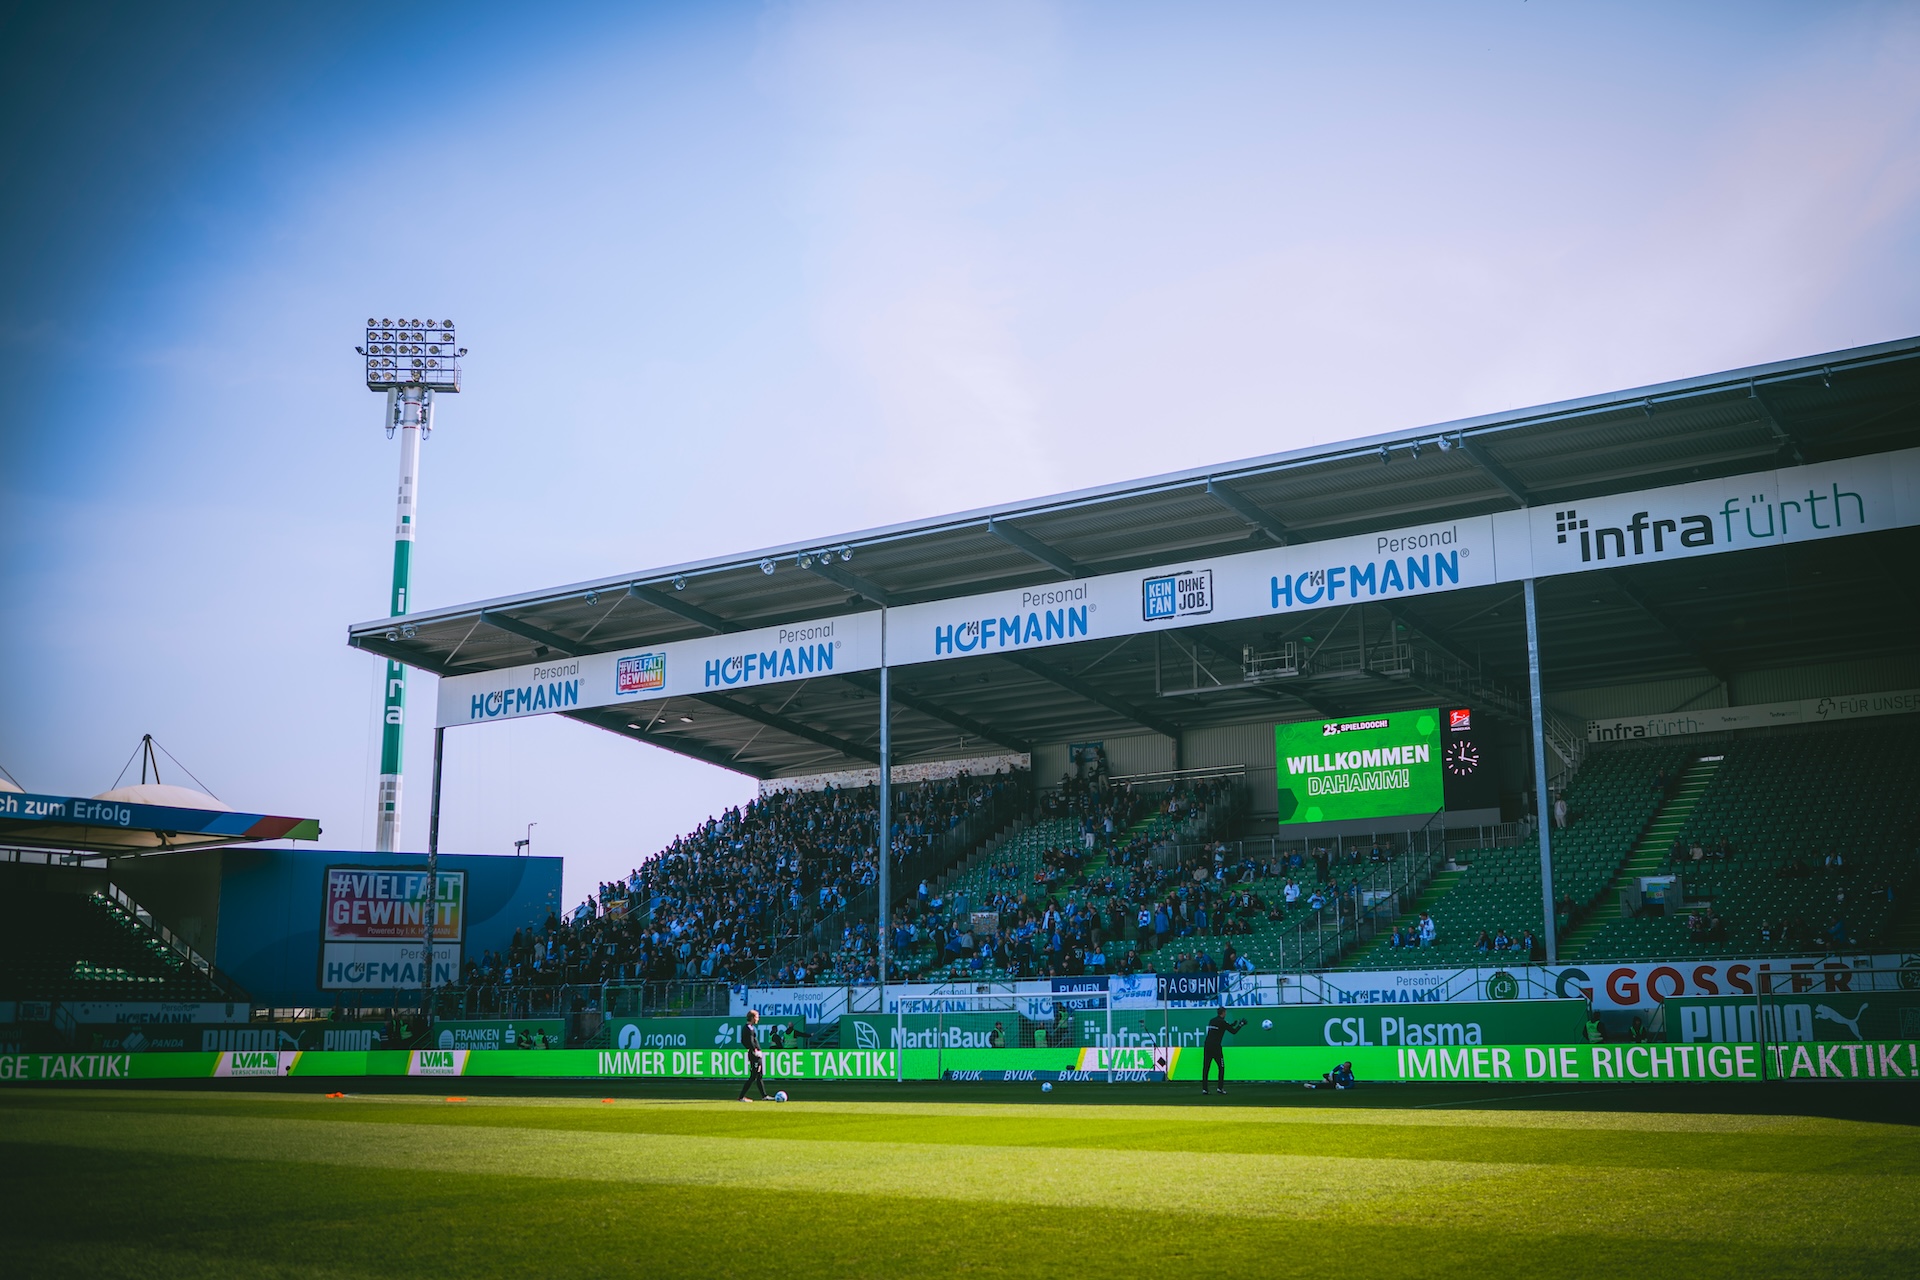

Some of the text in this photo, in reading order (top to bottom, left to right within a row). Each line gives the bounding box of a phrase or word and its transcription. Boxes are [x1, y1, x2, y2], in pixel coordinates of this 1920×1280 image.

[1579, 483, 1865, 562] infrafürth
[1377, 526, 1457, 554] Personal
[1149, 582, 1171, 597] KEIN
[1178, 576, 1205, 593] OHNE
[1271, 550, 1459, 609] HOFMANN
[1022, 583, 1087, 607] Personal
[1149, 596, 1172, 614] FAN
[1179, 591, 1208, 610] JOB.
[779, 621, 834, 643] Personal
[935, 605, 1088, 655] HOFMANN
[533, 661, 579, 680] Personal
[620, 657, 663, 674] #VIELFALT
[705, 642, 833, 687] HOFMANN
[620, 669, 662, 686] GEWINNT
[471, 679, 578, 719] HOFMANN
[1840, 698, 1868, 714] FÜR
[1595, 717, 1697, 741] infrafürth
[1287, 744, 1430, 775] WILLKOMMEN
[1308, 769, 1410, 796] DAHAMM!
[24, 800, 66, 817] zum
[73, 801, 131, 826] Erfolg
[332, 874, 458, 900] #VIELFALT
[367, 926, 395, 935] Powered
[396, 927, 404, 936] by
[401, 949, 451, 959] Persnal
[1396, 976, 1439, 986] Personal
[793, 992, 823, 1001] Personal
[1324, 1017, 1482, 1046] CSL Plasma
[1680, 1003, 1815, 1042] PUMA
[150, 1039, 184, 1048] PANDA
[202, 1029, 277, 1052] PUMA
[323, 1029, 371, 1051] PUMA
[455, 1029, 499, 1041] FRANKEN
[644, 1033, 686, 1049] signia
[38, 1055, 131, 1078] TAKTIK!
[598, 1052, 665, 1075] IMMER
[672, 1052, 703, 1075] DIE
[810, 1051, 895, 1077] TAKTIK!
[1397, 1043, 1920, 1078] IMMER DIE RICHTIGE TAKTIK!
